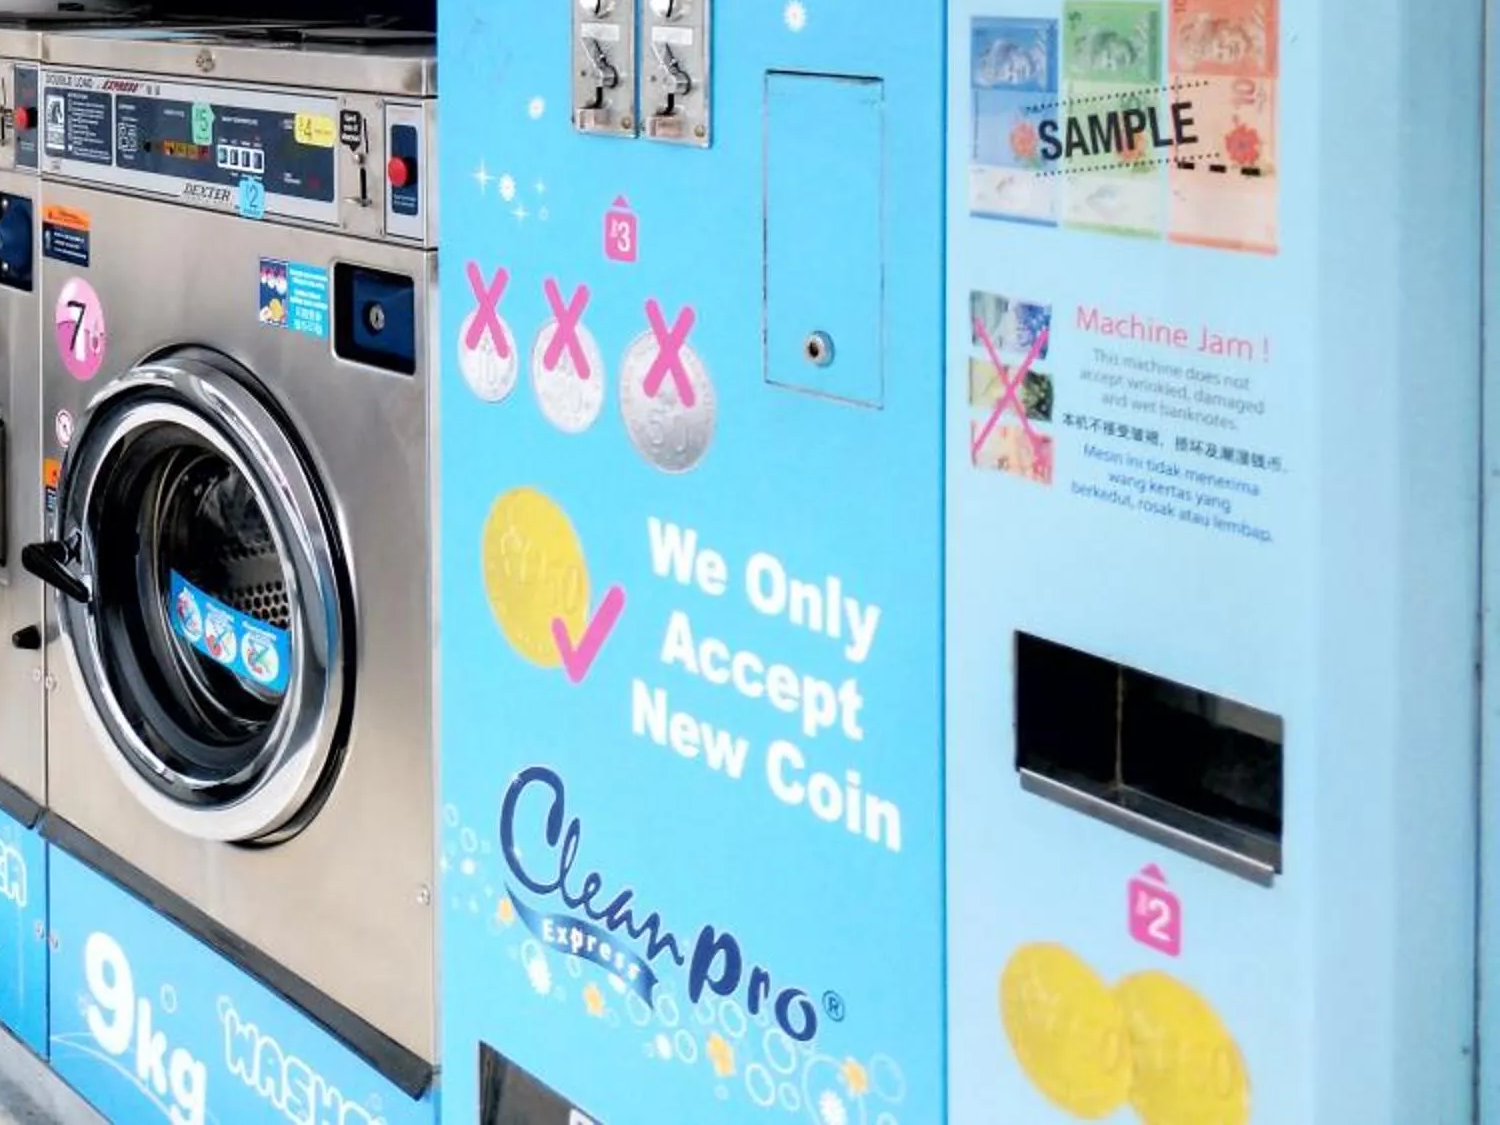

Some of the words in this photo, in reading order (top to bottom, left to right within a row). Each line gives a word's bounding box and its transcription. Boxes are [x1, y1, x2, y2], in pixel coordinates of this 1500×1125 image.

[1038, 102, 1199, 162] SAMPLE
[65, 300, 88, 363] 7
[1076, 305, 1188, 348] Machine
[1197, 326, 1254, 361] Jam
[1193, 387, 1265, 416] damaged
[647, 515, 729, 598] We
[744, 549, 882, 665] Only
[659, 609, 866, 742] Accept
[630, 679, 750, 780] New
[764, 739, 902, 854] Coin
[540, 917, 642, 981] Express
[83, 930, 209, 1125] 9kg
[216, 994, 389, 1125] WASH
